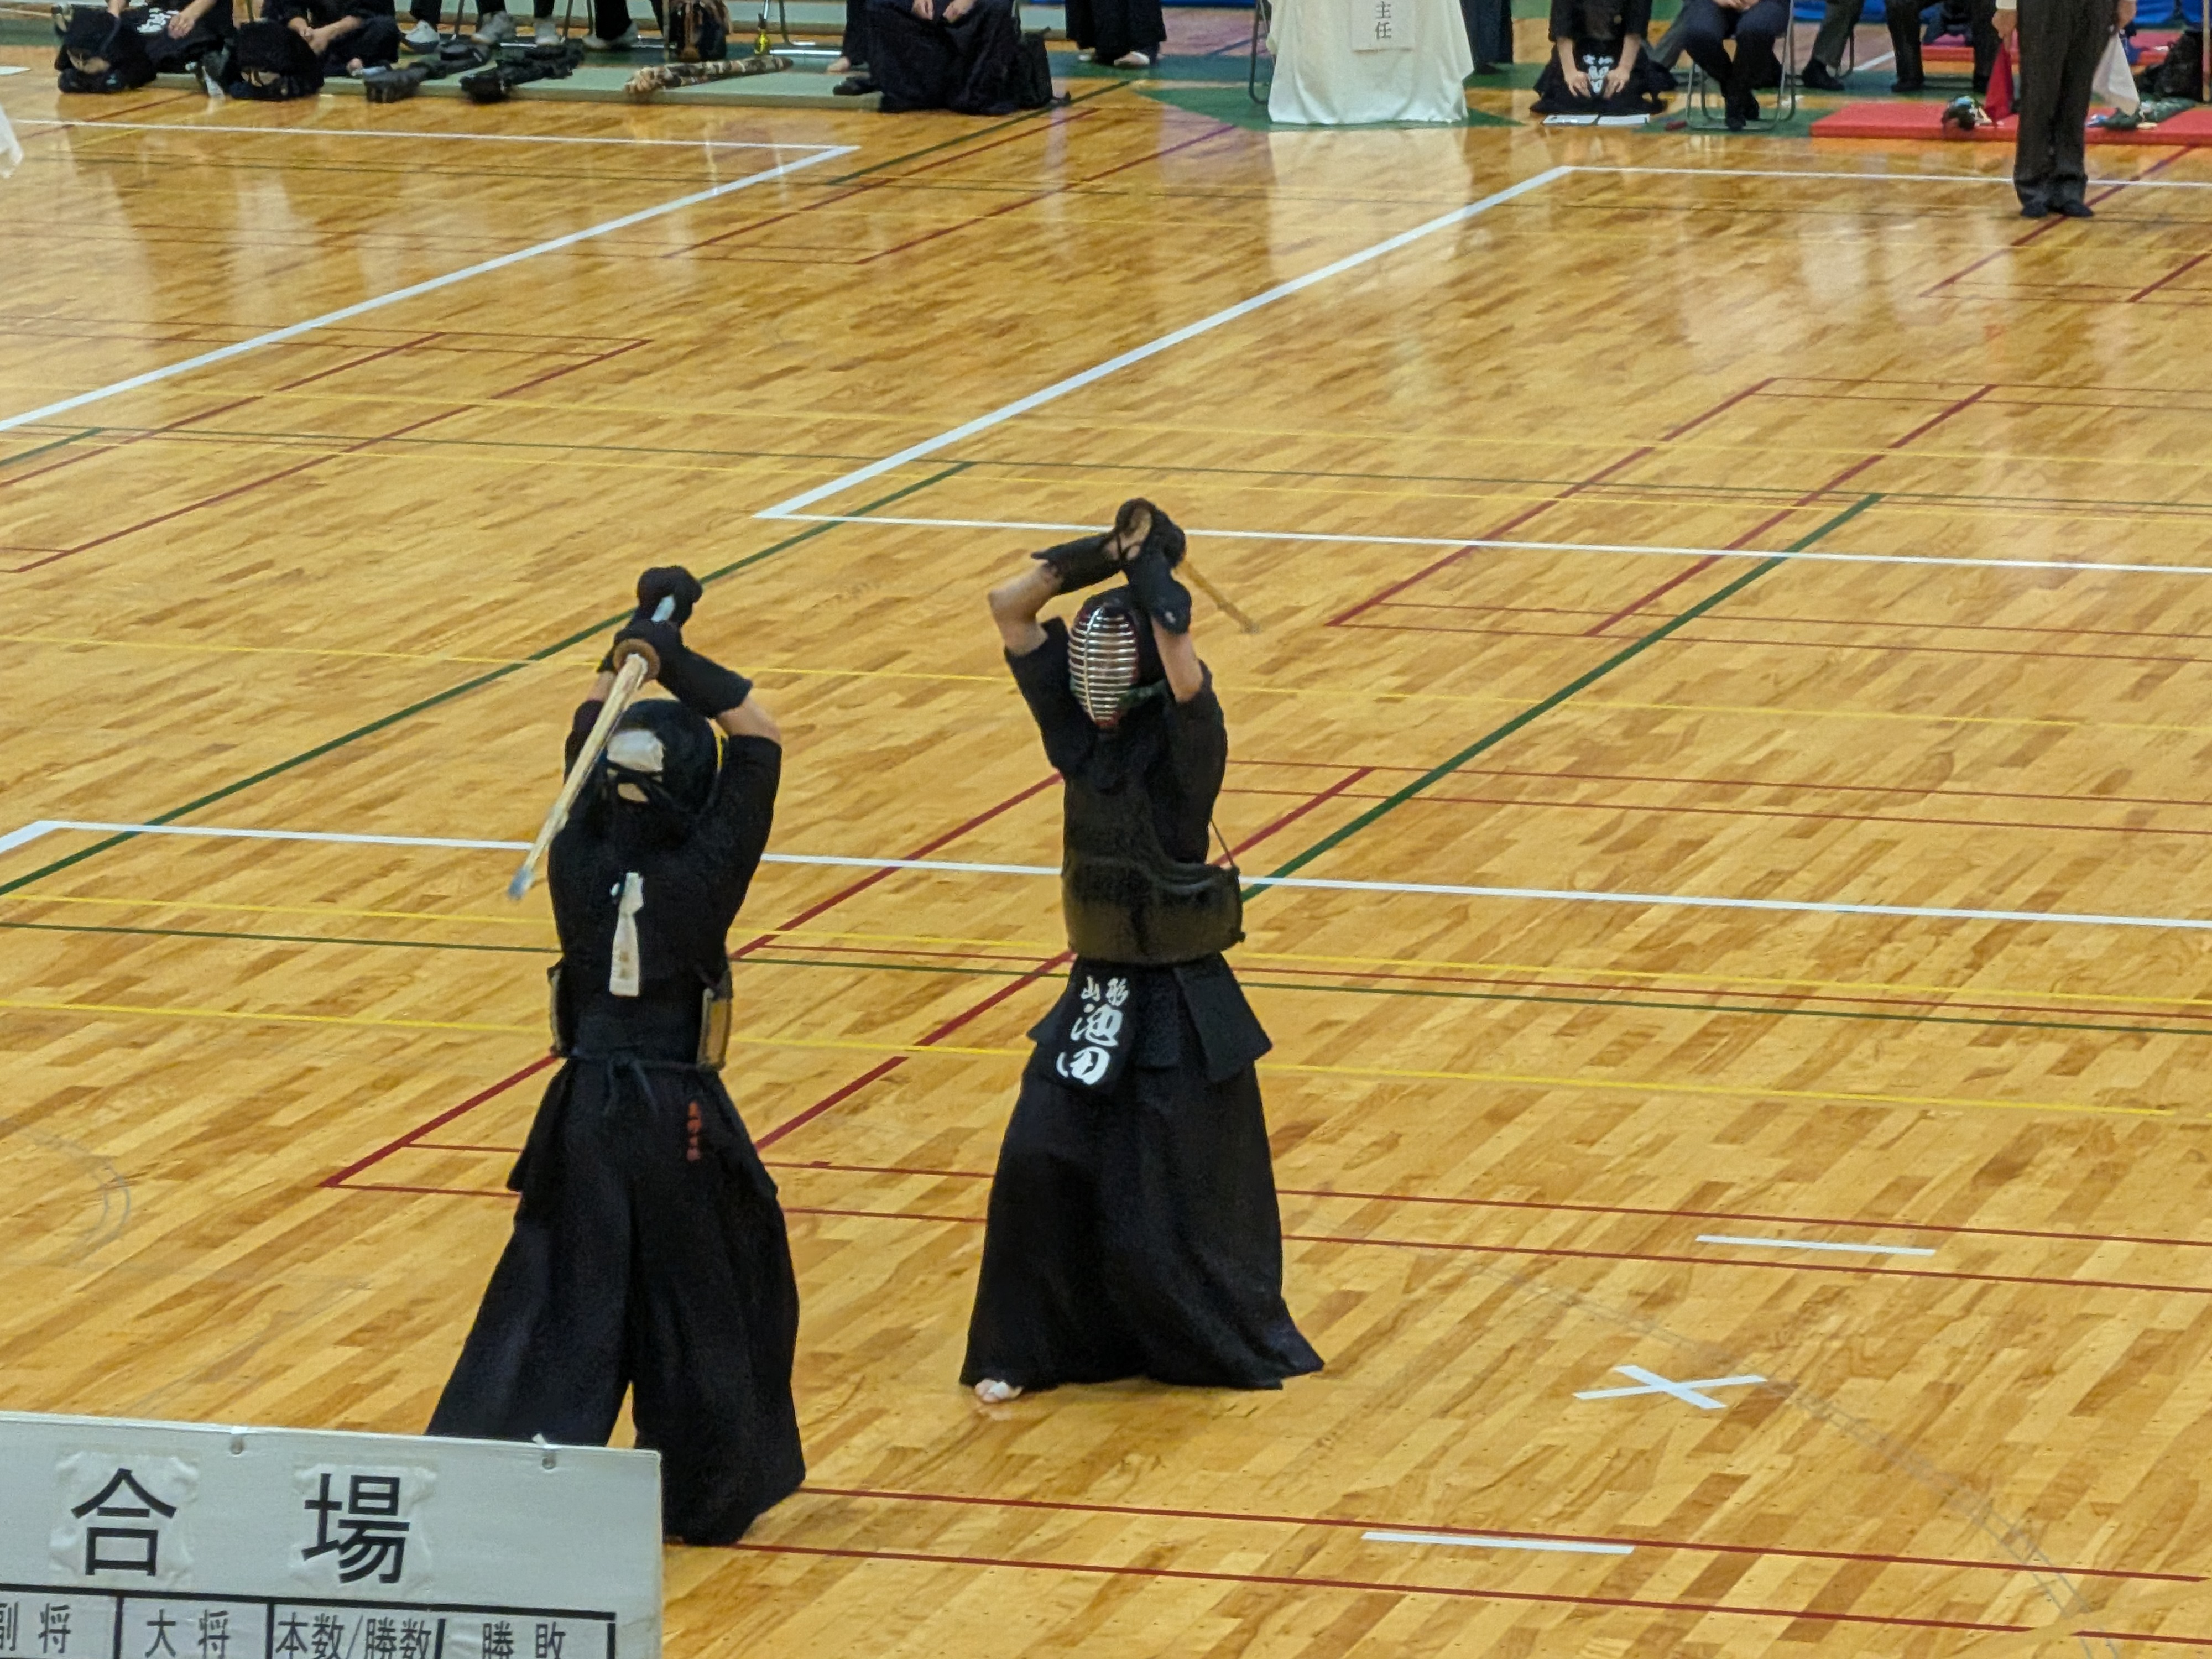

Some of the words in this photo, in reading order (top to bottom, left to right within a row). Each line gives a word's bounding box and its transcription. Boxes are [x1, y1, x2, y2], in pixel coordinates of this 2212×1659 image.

[1375, 1, 1392, 40] 主任
[145, 1608, 230, 1659] 大将
[483, 1620, 566, 1659] 勝敗
